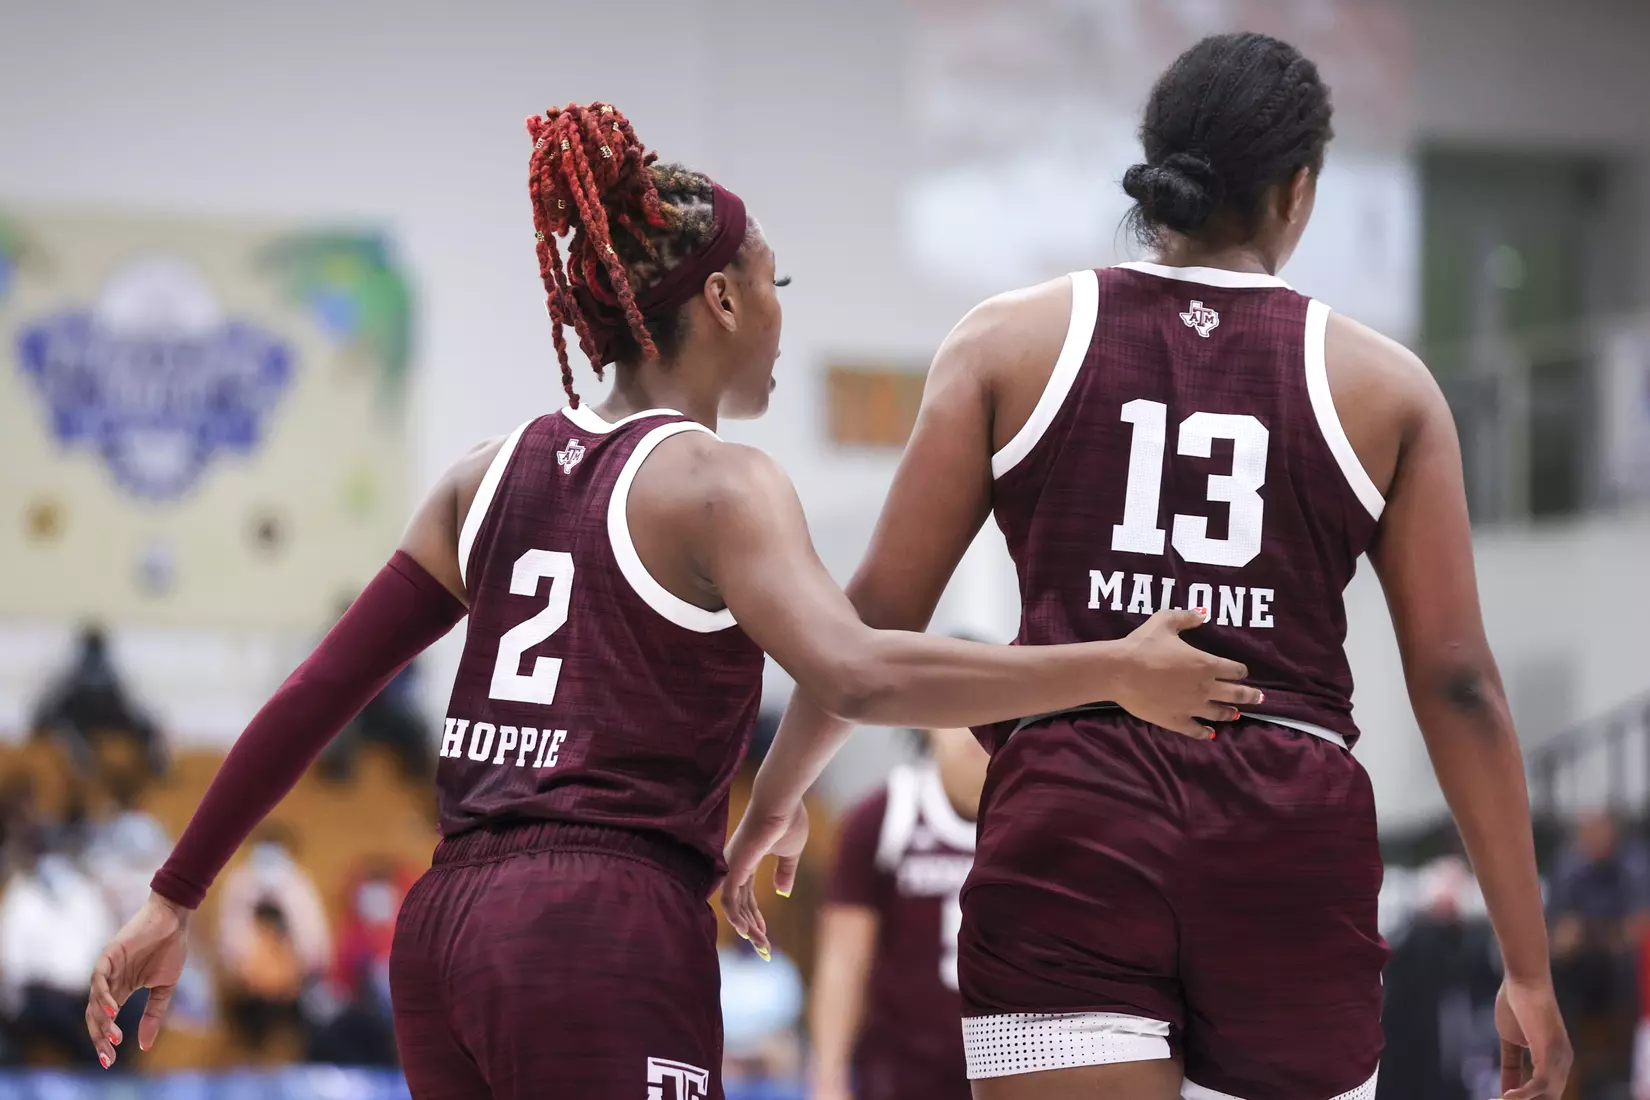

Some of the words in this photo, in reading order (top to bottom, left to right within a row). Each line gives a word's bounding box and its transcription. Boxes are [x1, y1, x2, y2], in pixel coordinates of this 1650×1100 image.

[1111, 398, 1269, 567] 13
[488, 549, 575, 705] 2
[1088, 570, 1275, 628] MALONE
[440, 718, 568, 768] HOPPIE
